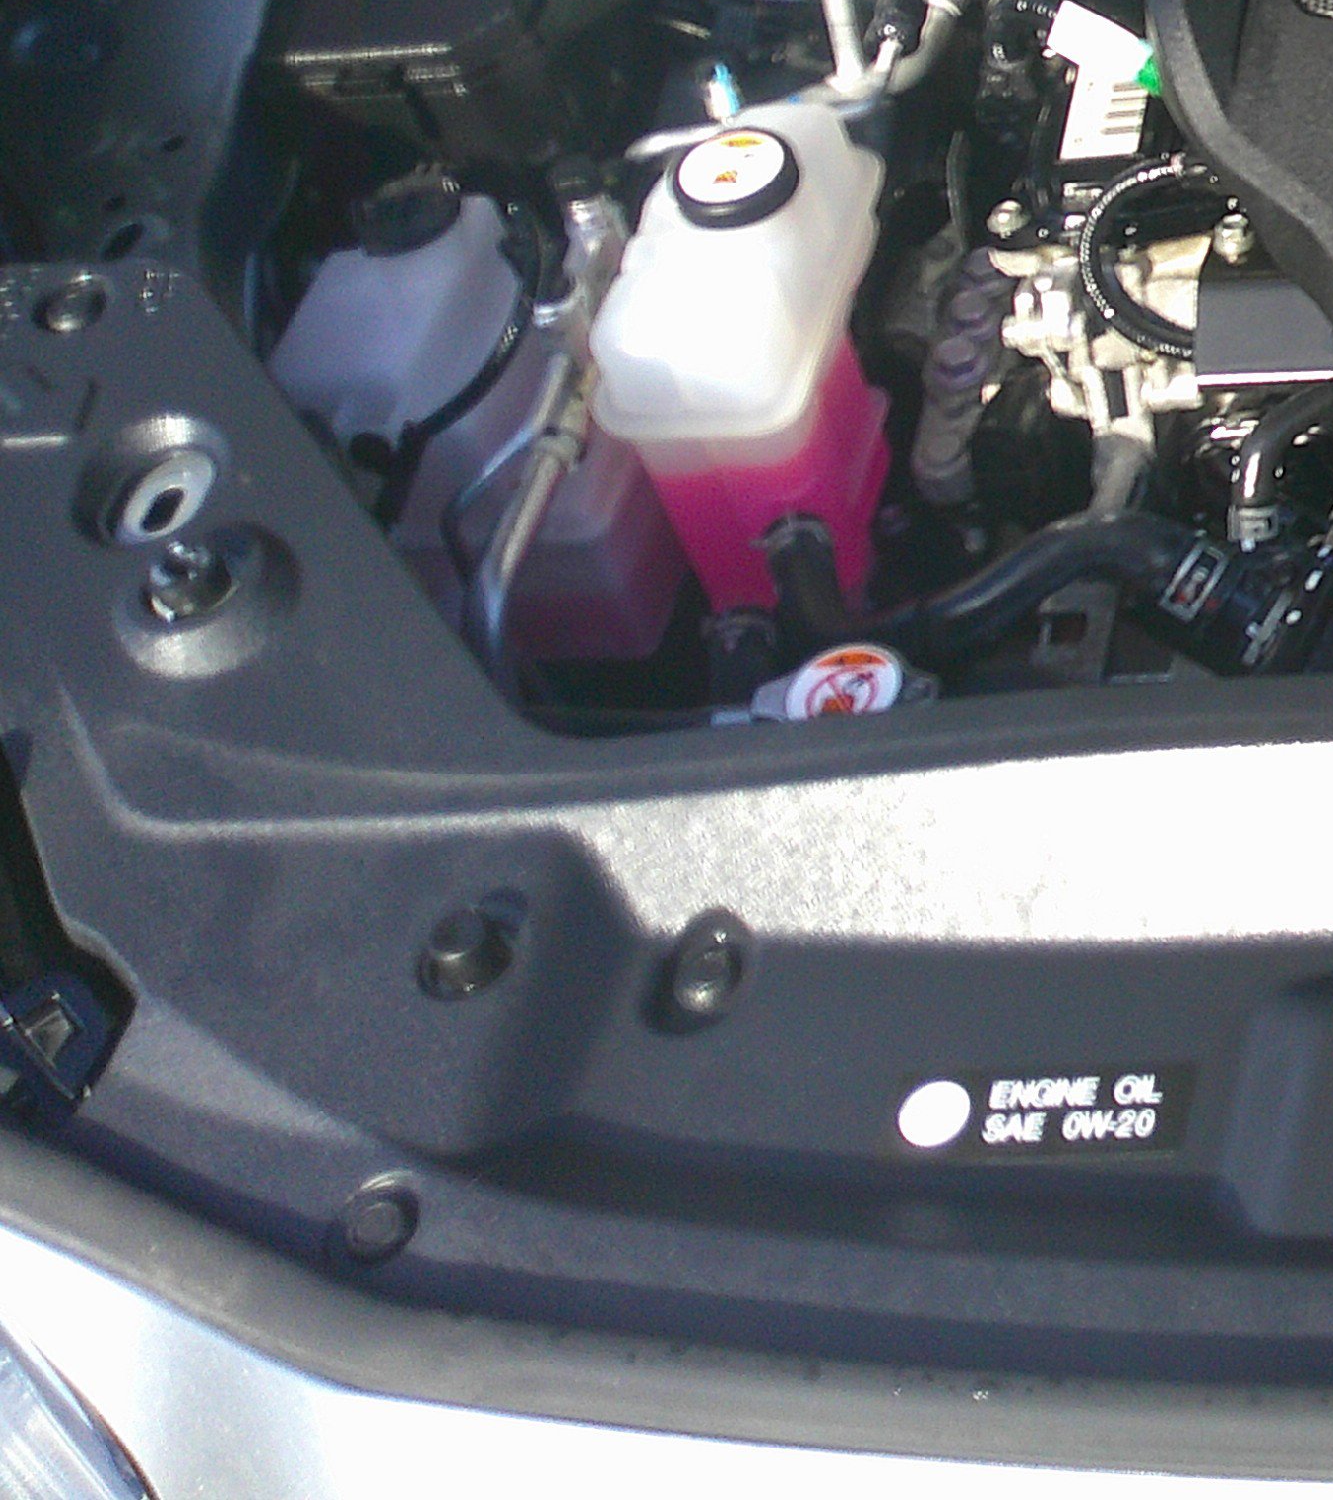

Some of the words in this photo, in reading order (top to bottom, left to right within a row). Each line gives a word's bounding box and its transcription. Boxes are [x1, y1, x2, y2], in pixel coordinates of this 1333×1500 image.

[988, 1076, 1100, 1110] ENGINE
[1113, 1073, 1163, 1105] OIL
[982, 1111, 1048, 1144] SAE
[1062, 1108, 1156, 1141] 0W-20
